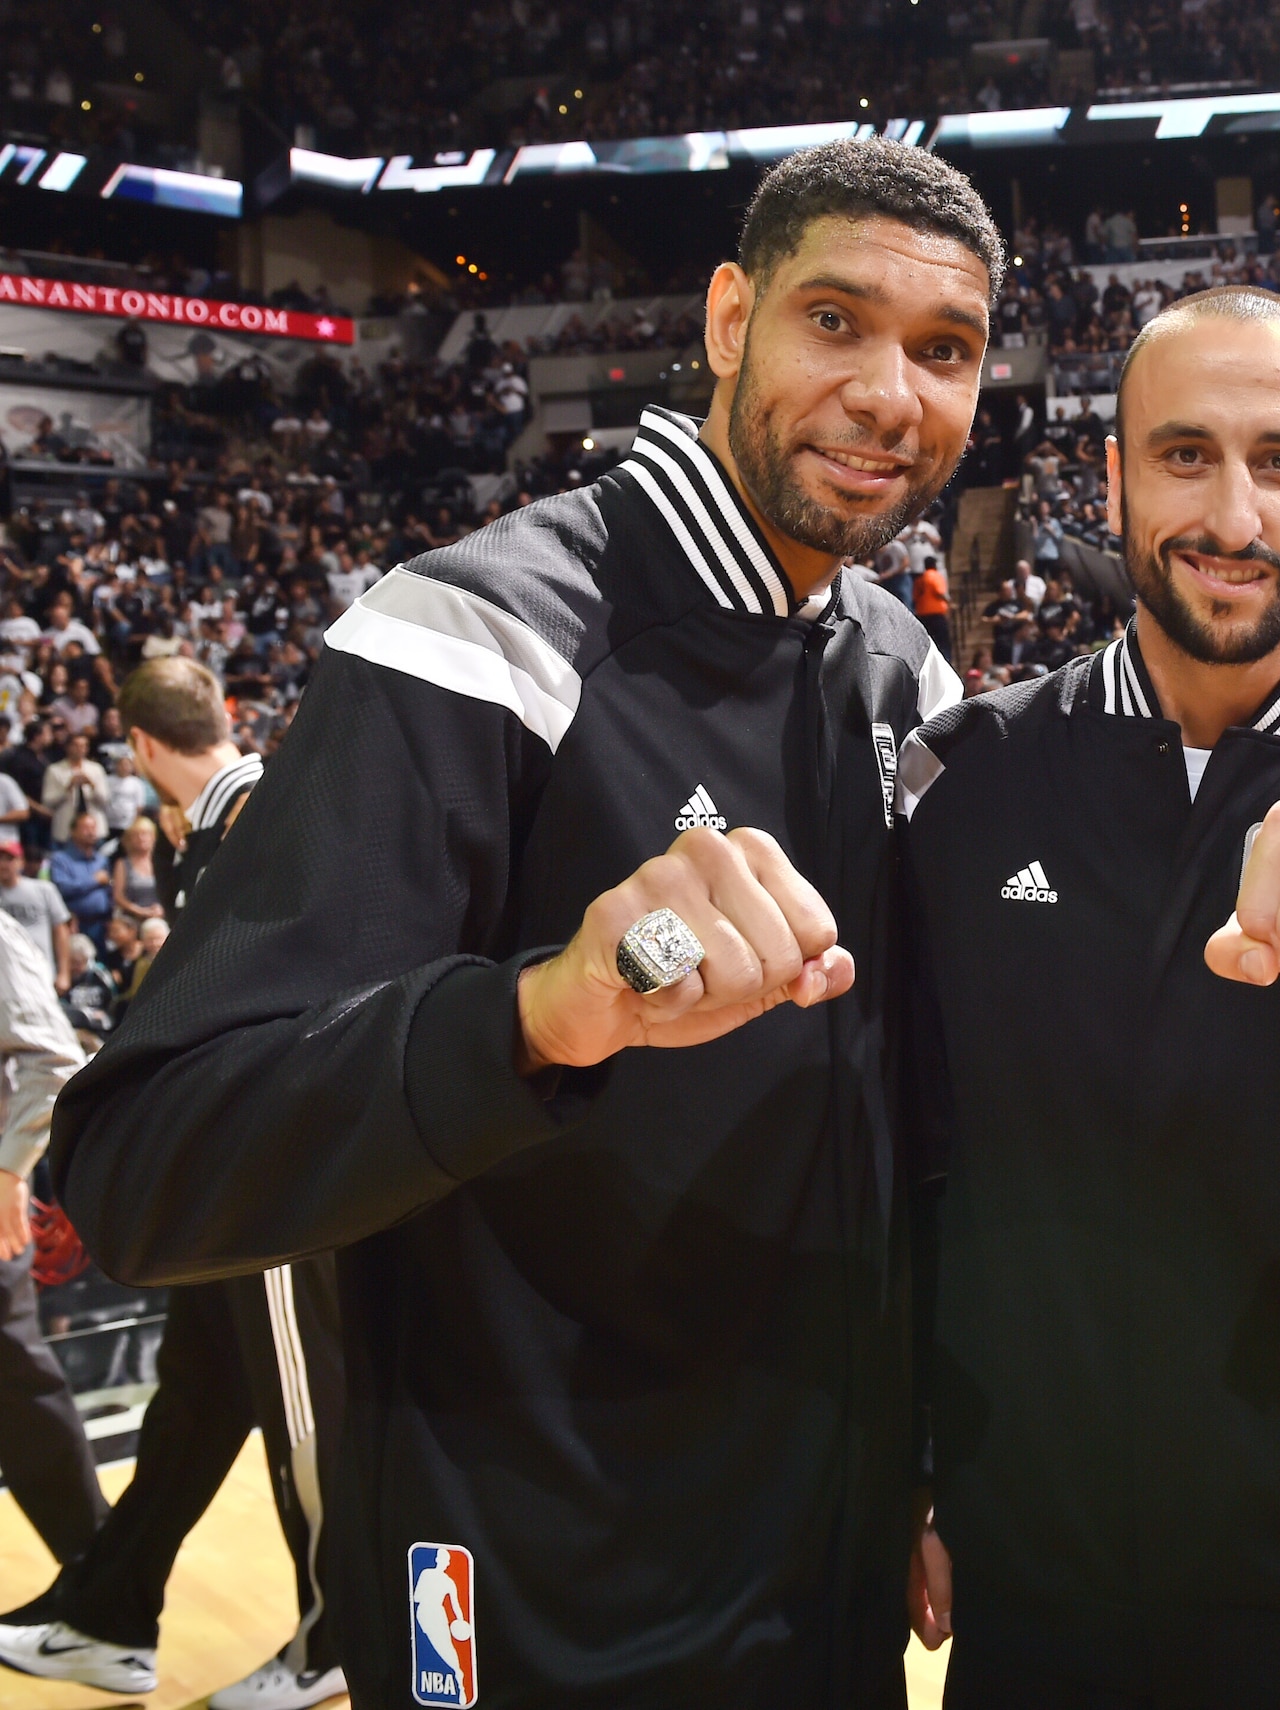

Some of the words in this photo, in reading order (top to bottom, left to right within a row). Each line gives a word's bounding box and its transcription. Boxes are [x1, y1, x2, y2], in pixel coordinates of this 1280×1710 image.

[674, 813, 727, 831] adidas
[1001, 884, 1059, 904] adidas
[421, 1670, 457, 1696] NBA
